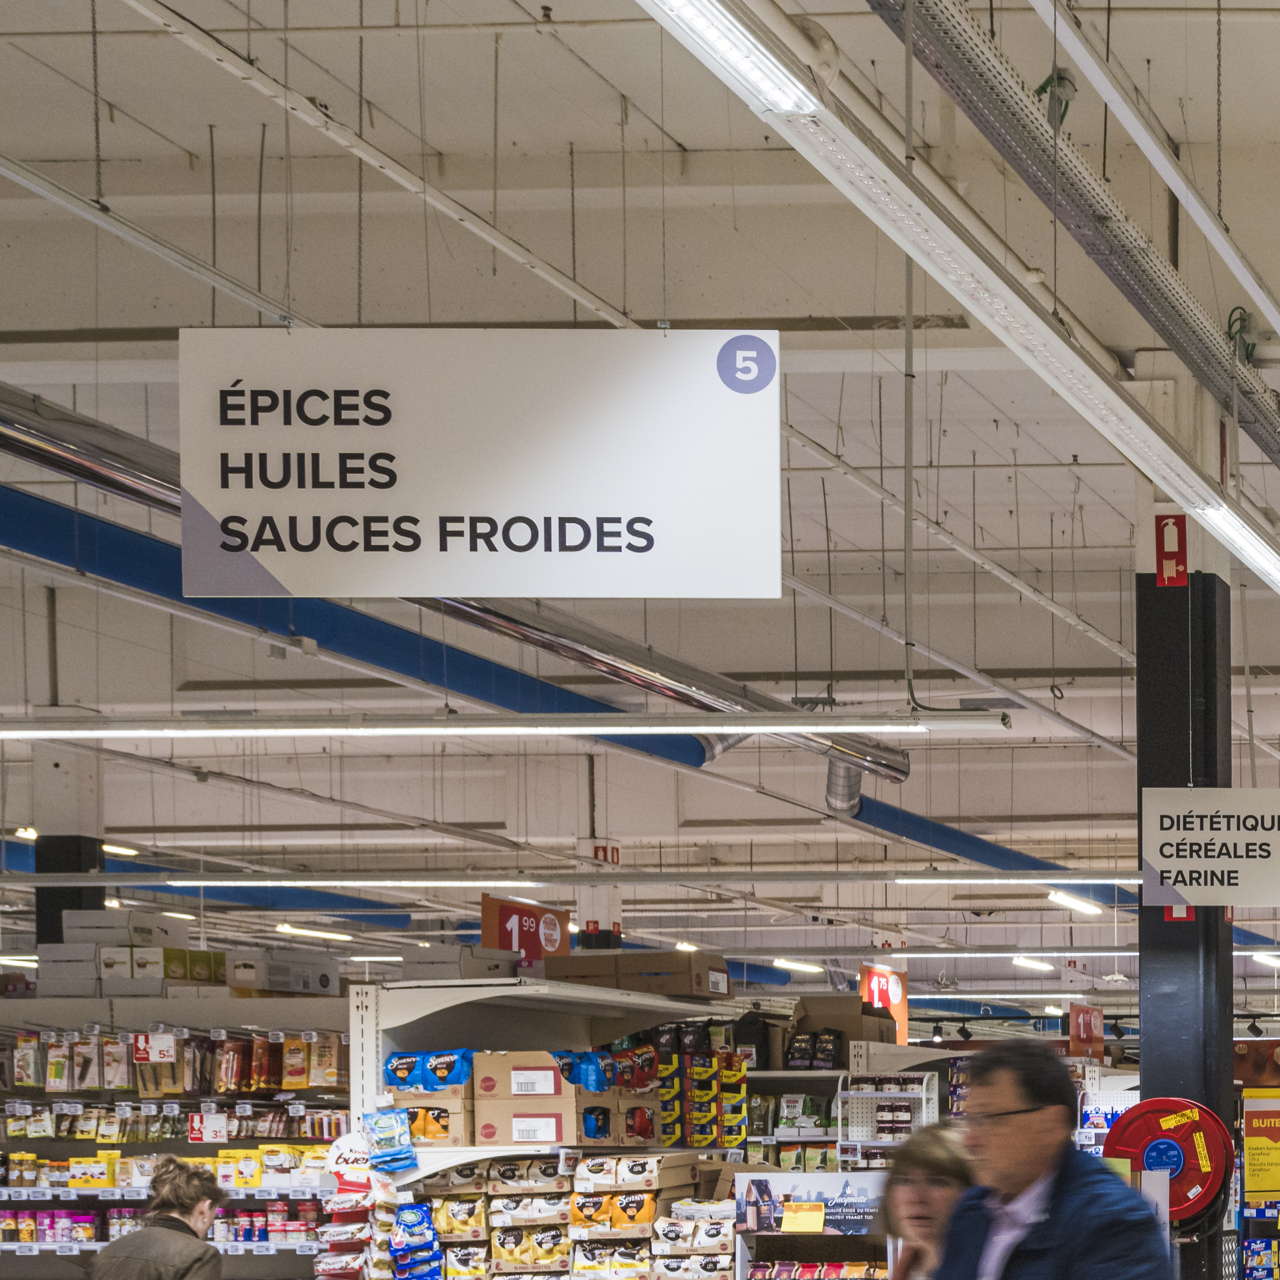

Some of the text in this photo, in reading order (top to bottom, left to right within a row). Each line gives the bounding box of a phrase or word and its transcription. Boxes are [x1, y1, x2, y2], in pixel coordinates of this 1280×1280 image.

[735, 351, 758, 380] 5
[219, 380, 392, 426] ÉPICES
[220, 453, 398, 489] HUILES
[220, 515, 654, 553] SAUCES FROIDES
[1159, 837, 1271, 860] CÉRÉALES
[1160, 870, 1239, 887] FARINE
